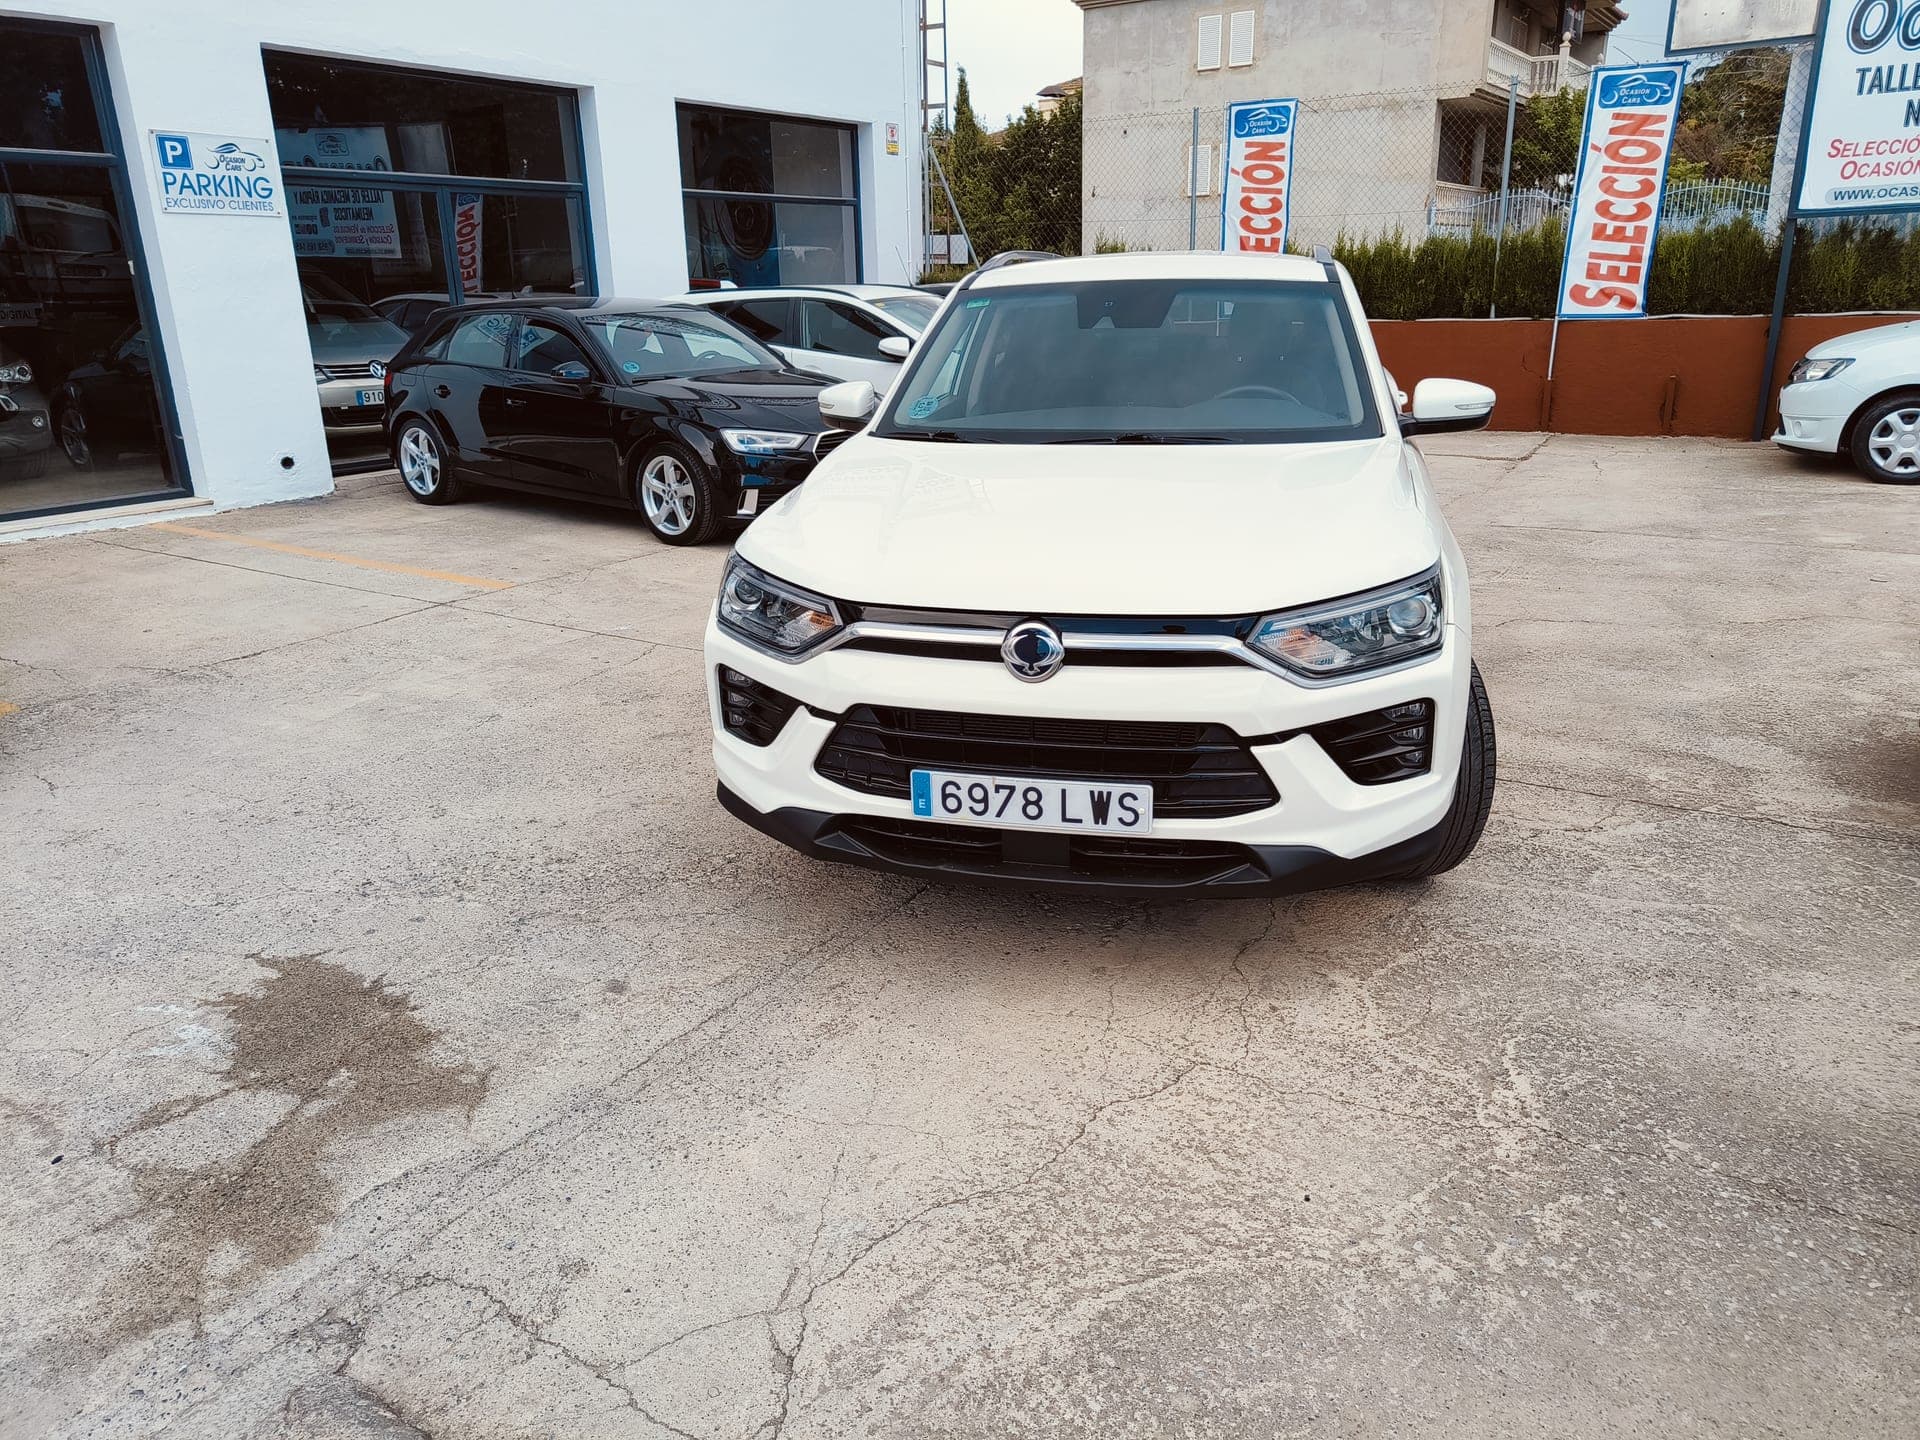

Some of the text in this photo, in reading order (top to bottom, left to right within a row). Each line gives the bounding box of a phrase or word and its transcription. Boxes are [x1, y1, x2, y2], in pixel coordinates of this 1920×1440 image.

[1619, 88, 1651, 96] OCASION
[1622, 96, 1641, 104] CARS
[219, 154, 246, 165] OCASION
[225, 163, 242, 172] CARS
[162, 171, 273, 199] PARKING
[1834, 186, 1920, 201] WWW.OCAS
[165, 197, 275, 212] EXCLUSIVO CLIENTES
[1569, 112, 1668, 311] SELECCIÓN
[363, 391, 384, 403] 910
[941, 780, 1140, 827] 6978 LWS
